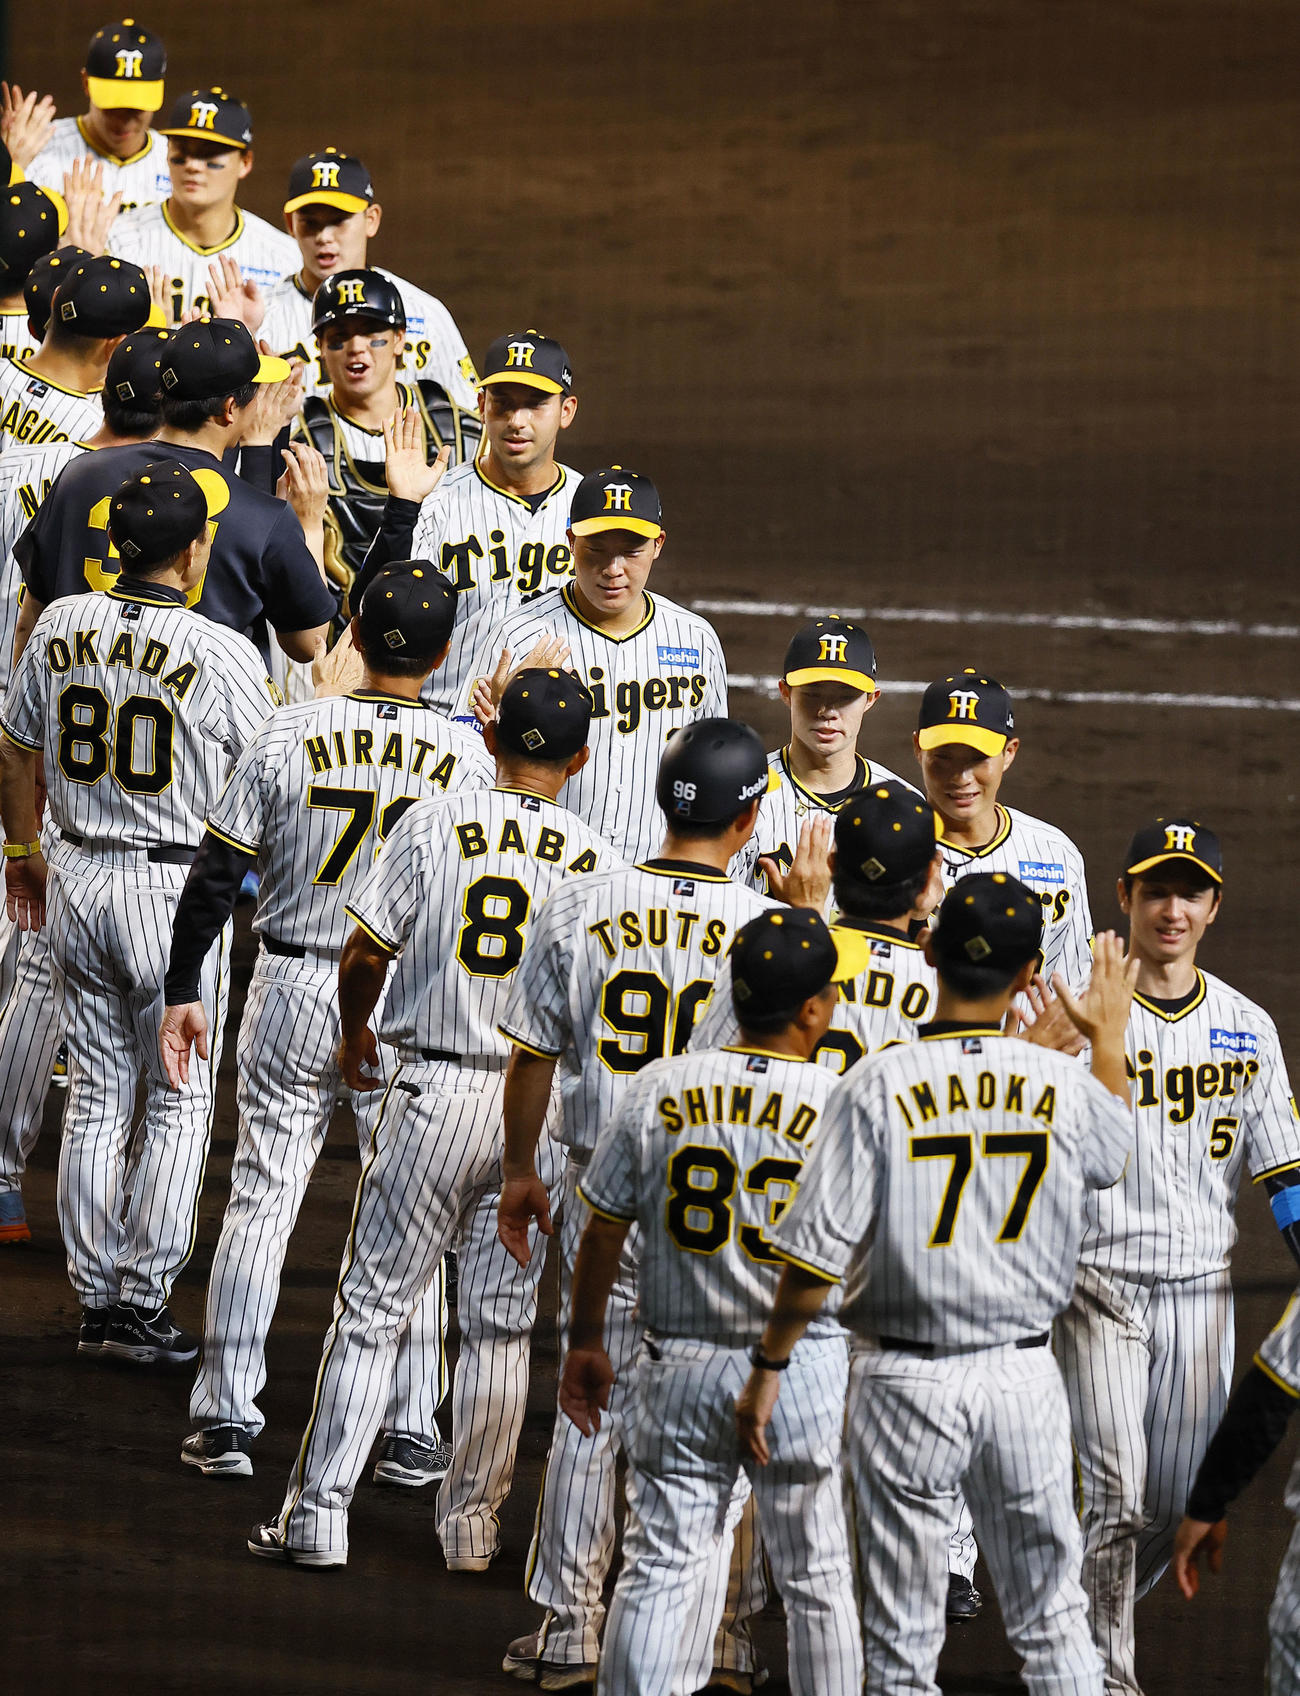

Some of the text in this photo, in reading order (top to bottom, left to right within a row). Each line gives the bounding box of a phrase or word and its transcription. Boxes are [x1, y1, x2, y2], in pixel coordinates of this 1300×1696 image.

[440, 529, 576, 593] Tige
[48, 629, 199, 702] OKADA
[659, 649, 700, 668] Joshin
[572, 666, 707, 735] igers
[57, 682, 175, 796] 80
[304, 729, 457, 791] HIRATA
[673, 780, 697, 801] 96
[454, 818, 597, 875] BABA
[1020, 864, 1065, 882] Joshin
[588, 908, 740, 959] TSUTS
[1211, 1031, 1257, 1050] Joshin
[658, 1084, 818, 1150] SHIMAD
[895, 1071, 1056, 1131] IMAOKA
[1125, 1049, 1259, 1124] igers
[1209, 1117, 1240, 1160] 5
[907, 1130, 1051, 1248] 77
